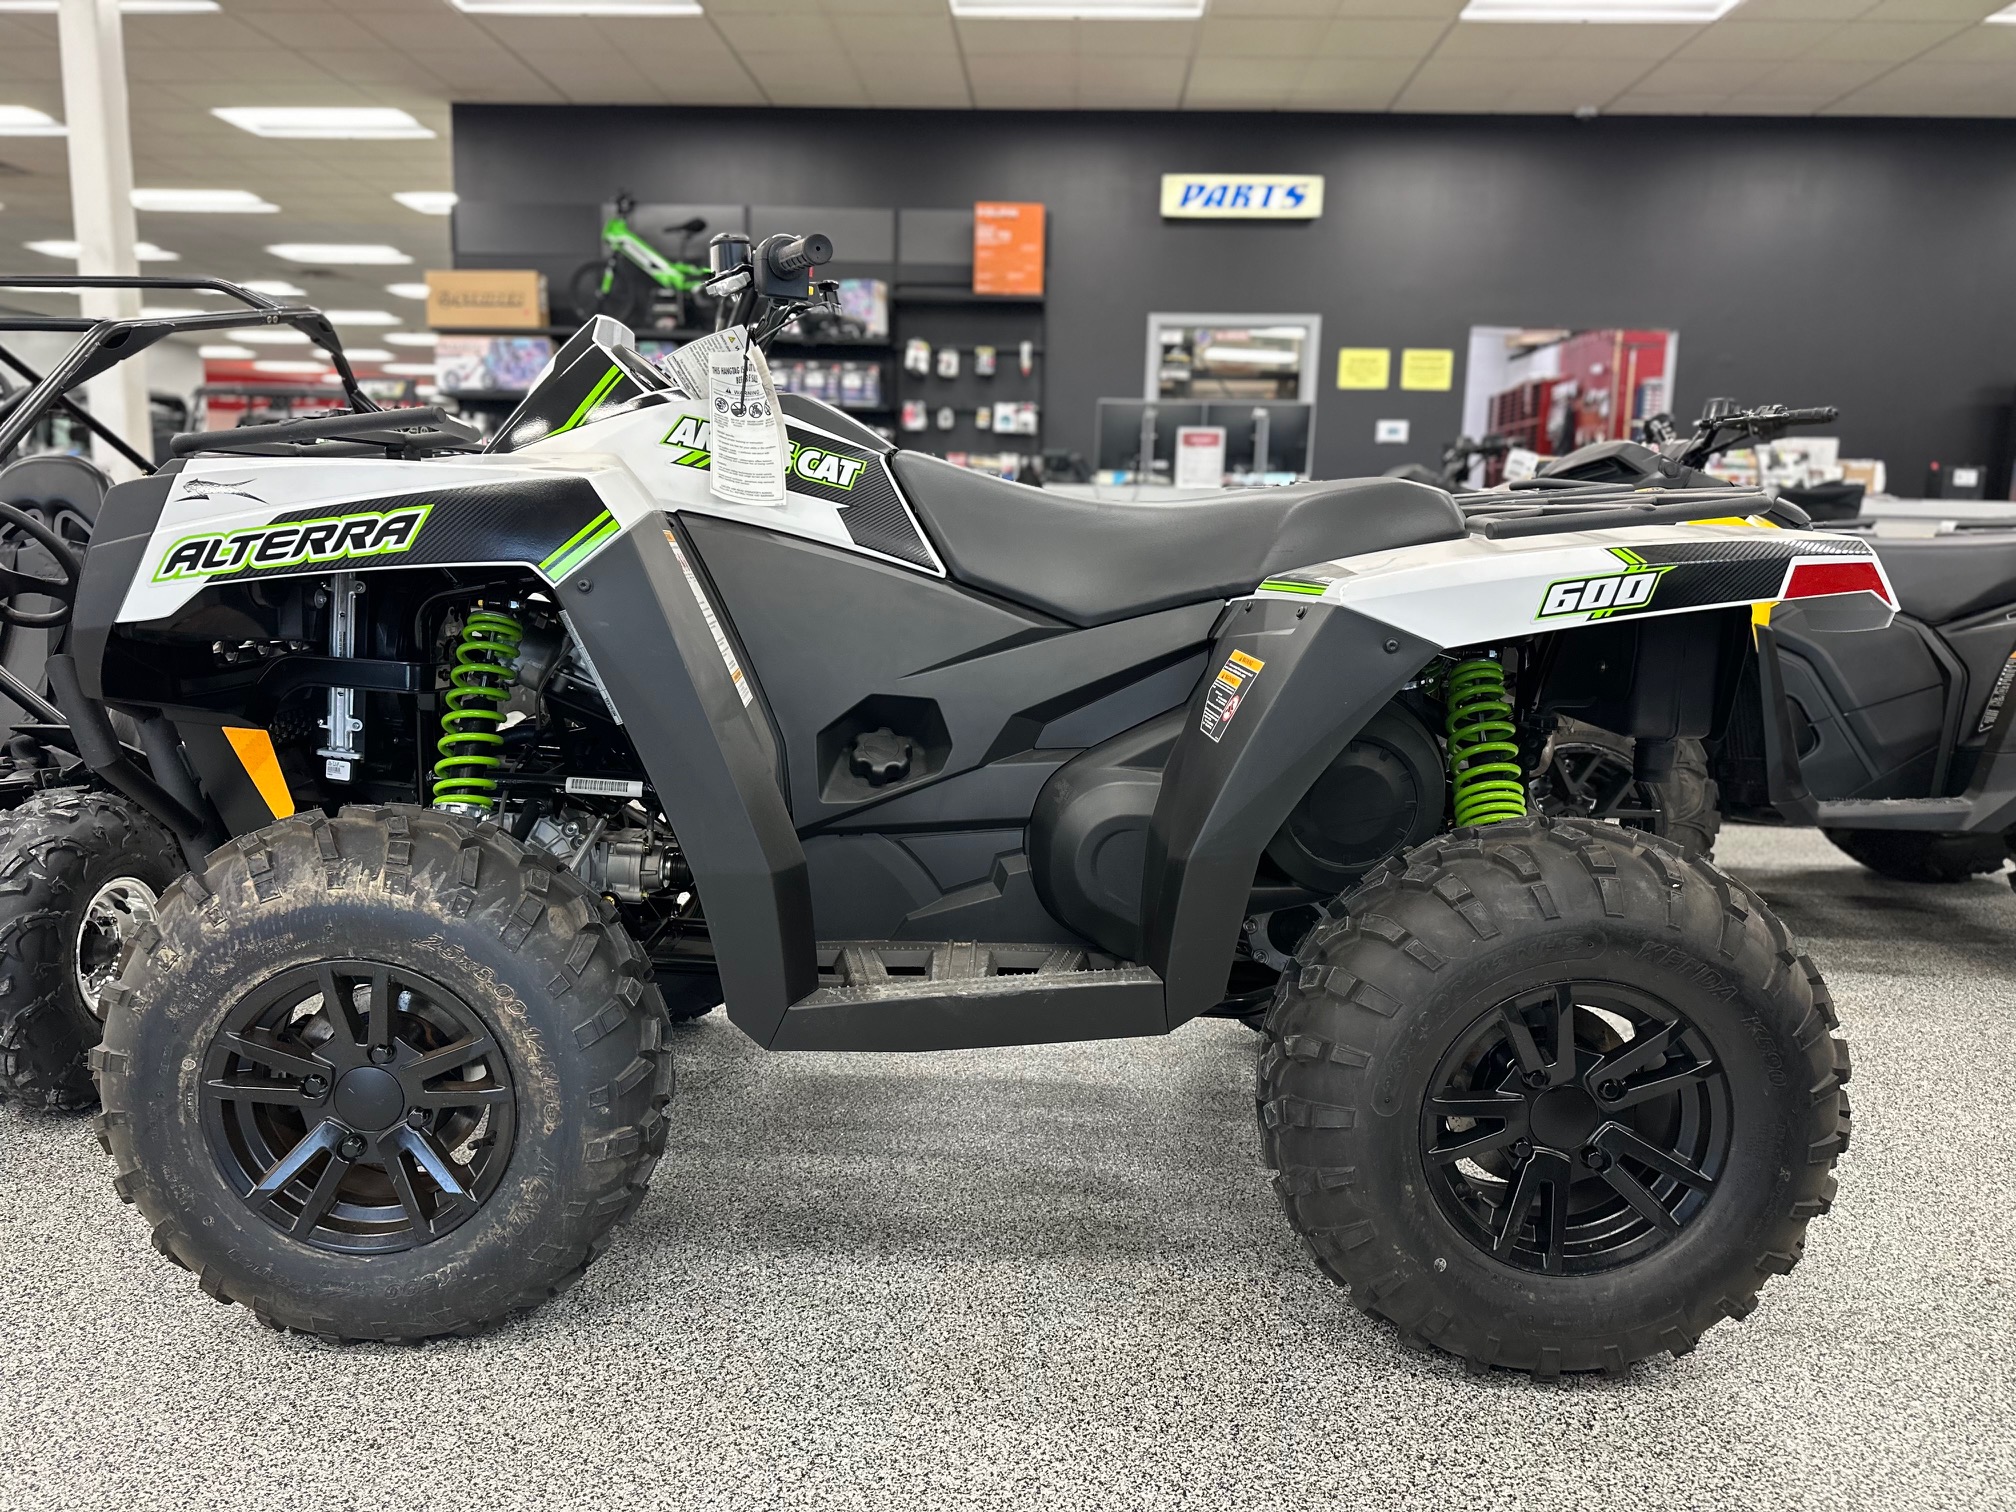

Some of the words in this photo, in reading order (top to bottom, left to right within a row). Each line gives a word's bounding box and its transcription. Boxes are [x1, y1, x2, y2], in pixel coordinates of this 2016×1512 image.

[1178, 183, 1308, 209] PARTS
[796, 448, 863, 488] CAT
[162, 512, 422, 575] ALTERRA
[1541, 572, 1658, 616] 600
[1634, 940, 1739, 1003] KENDA
